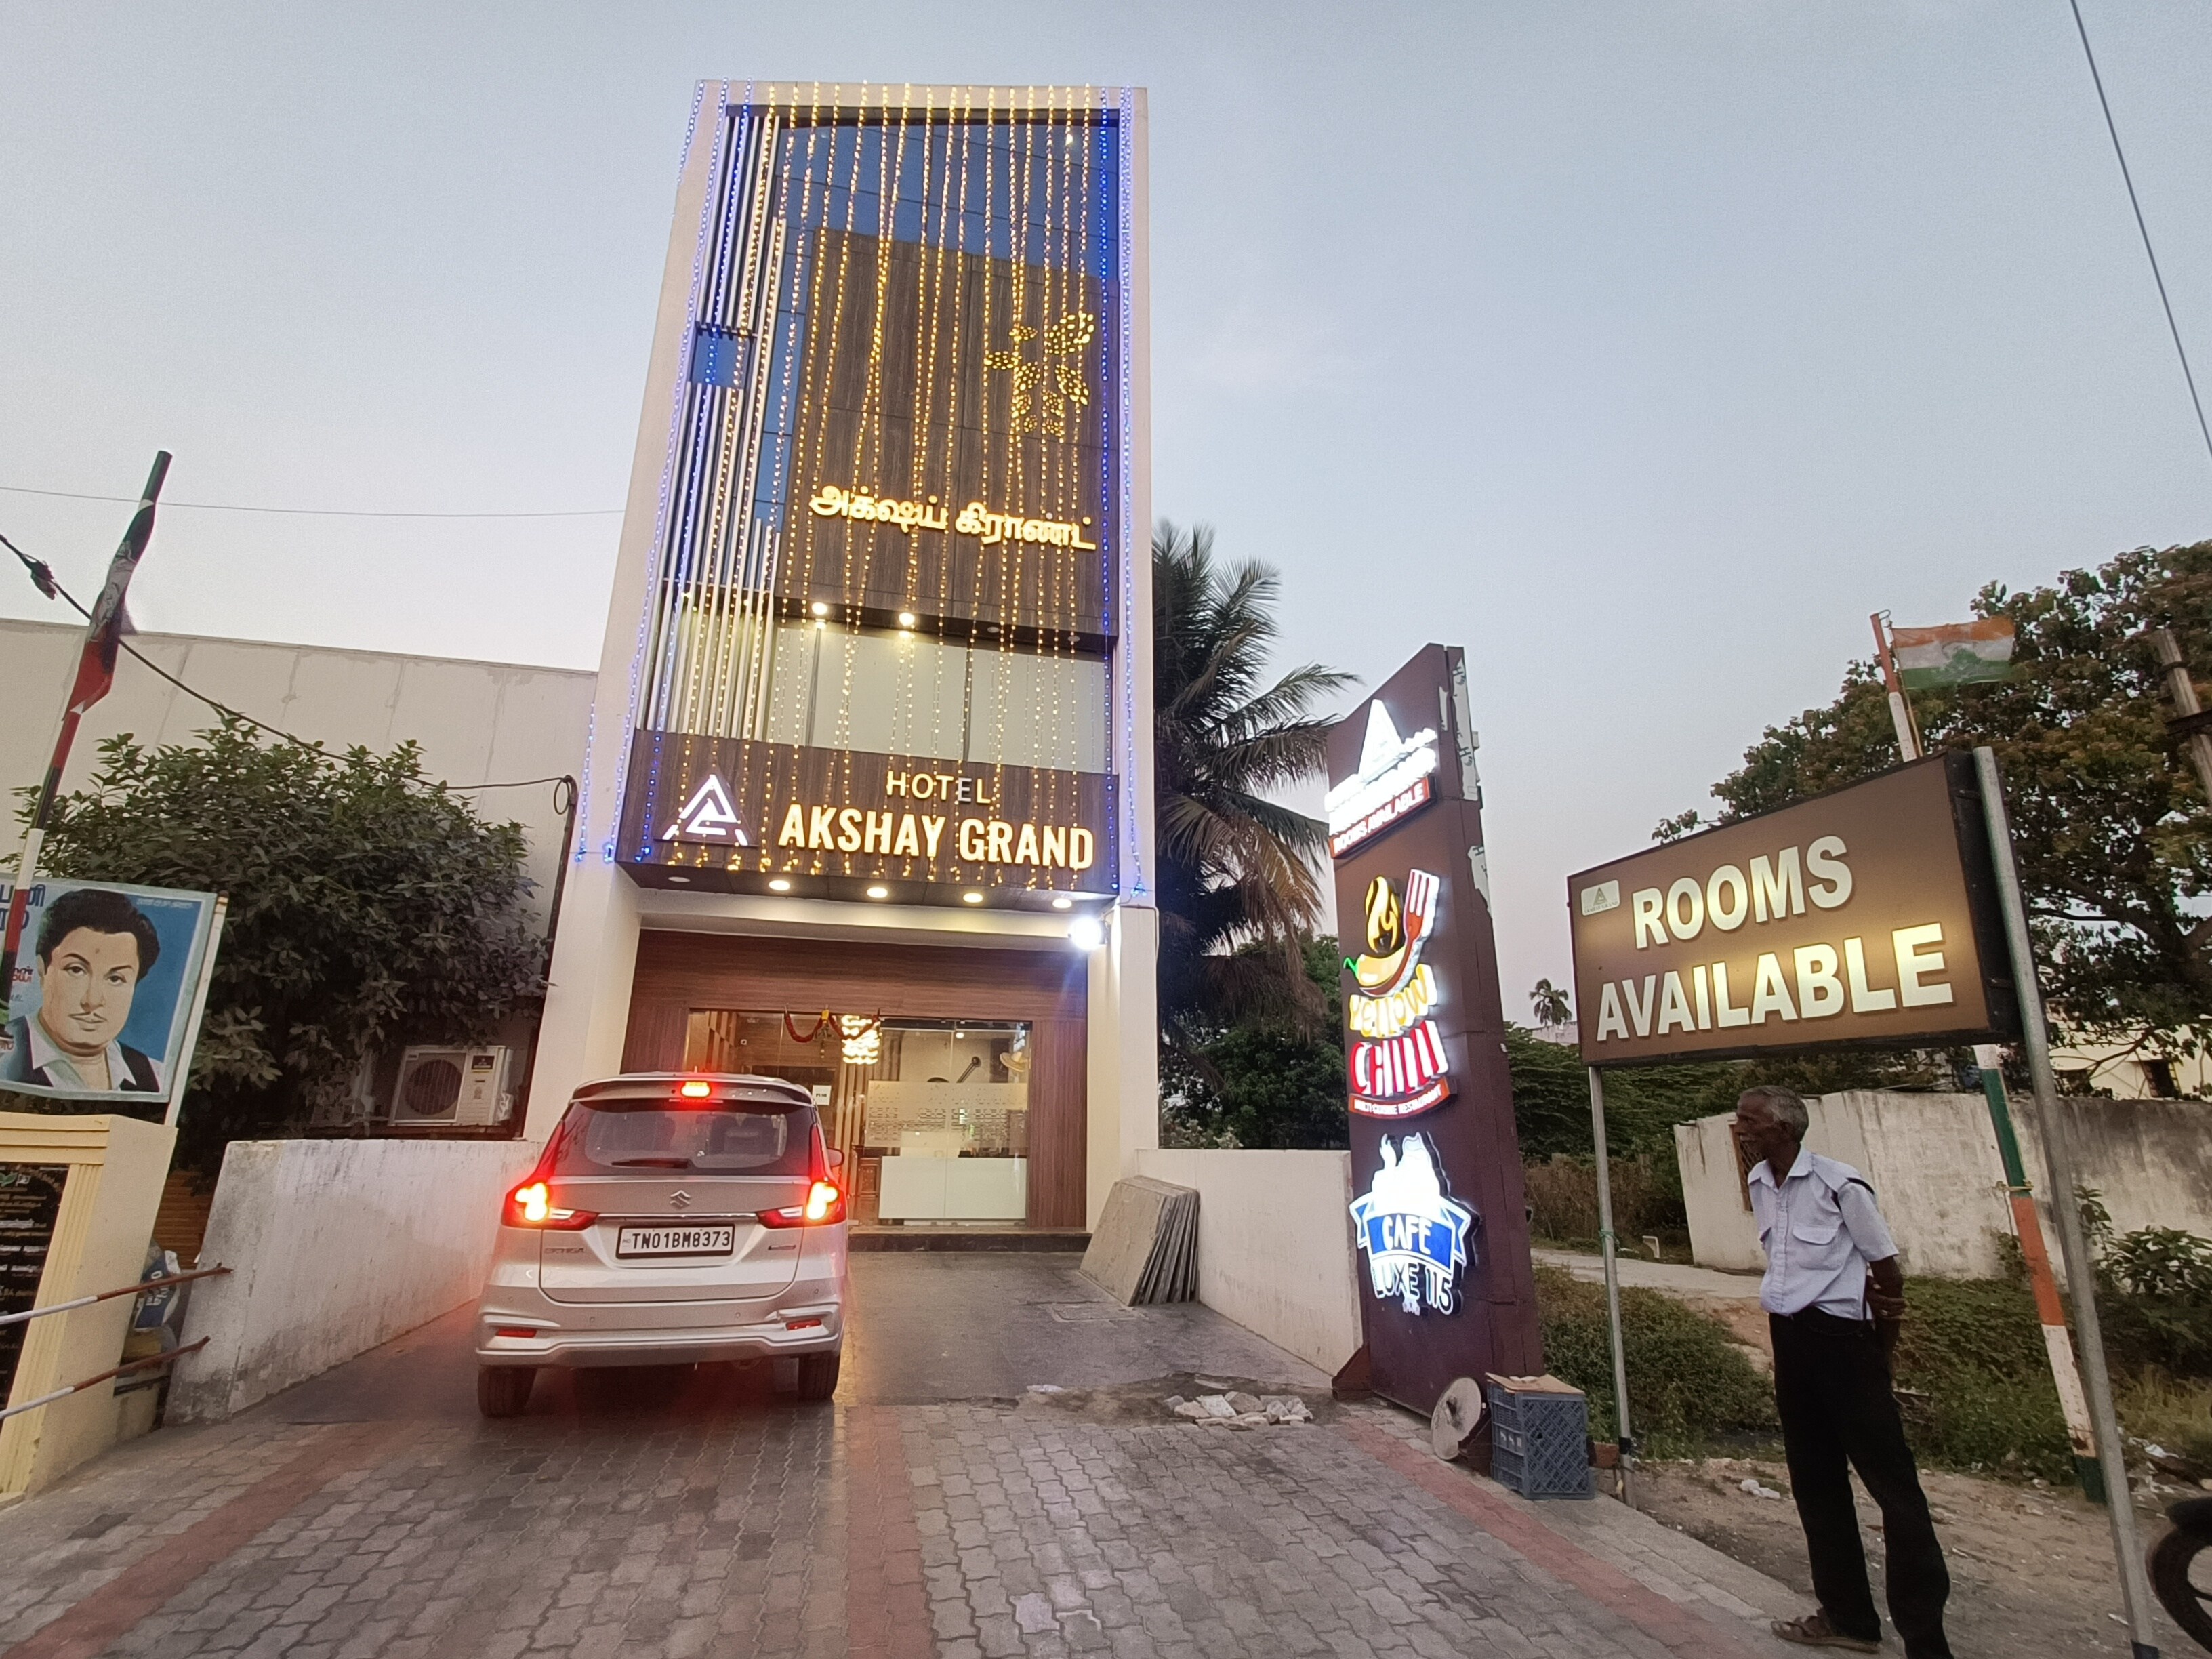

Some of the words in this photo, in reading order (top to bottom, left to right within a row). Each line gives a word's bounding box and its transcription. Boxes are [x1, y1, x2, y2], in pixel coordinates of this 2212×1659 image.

[886, 770, 991, 804] HOTEL
[778, 804, 946, 858] AKSHAY
[958, 819, 1094, 870] GRAND
[1632, 835, 1853, 950] ROOMS
[1596, 922, 1954, 1042] AVAILABLE
[1350, 1019, 1448, 1097] CHILLI
[632, 1231, 731, 1249] TN01BM8373
[1382, 1215, 1433, 1255] CAFE
